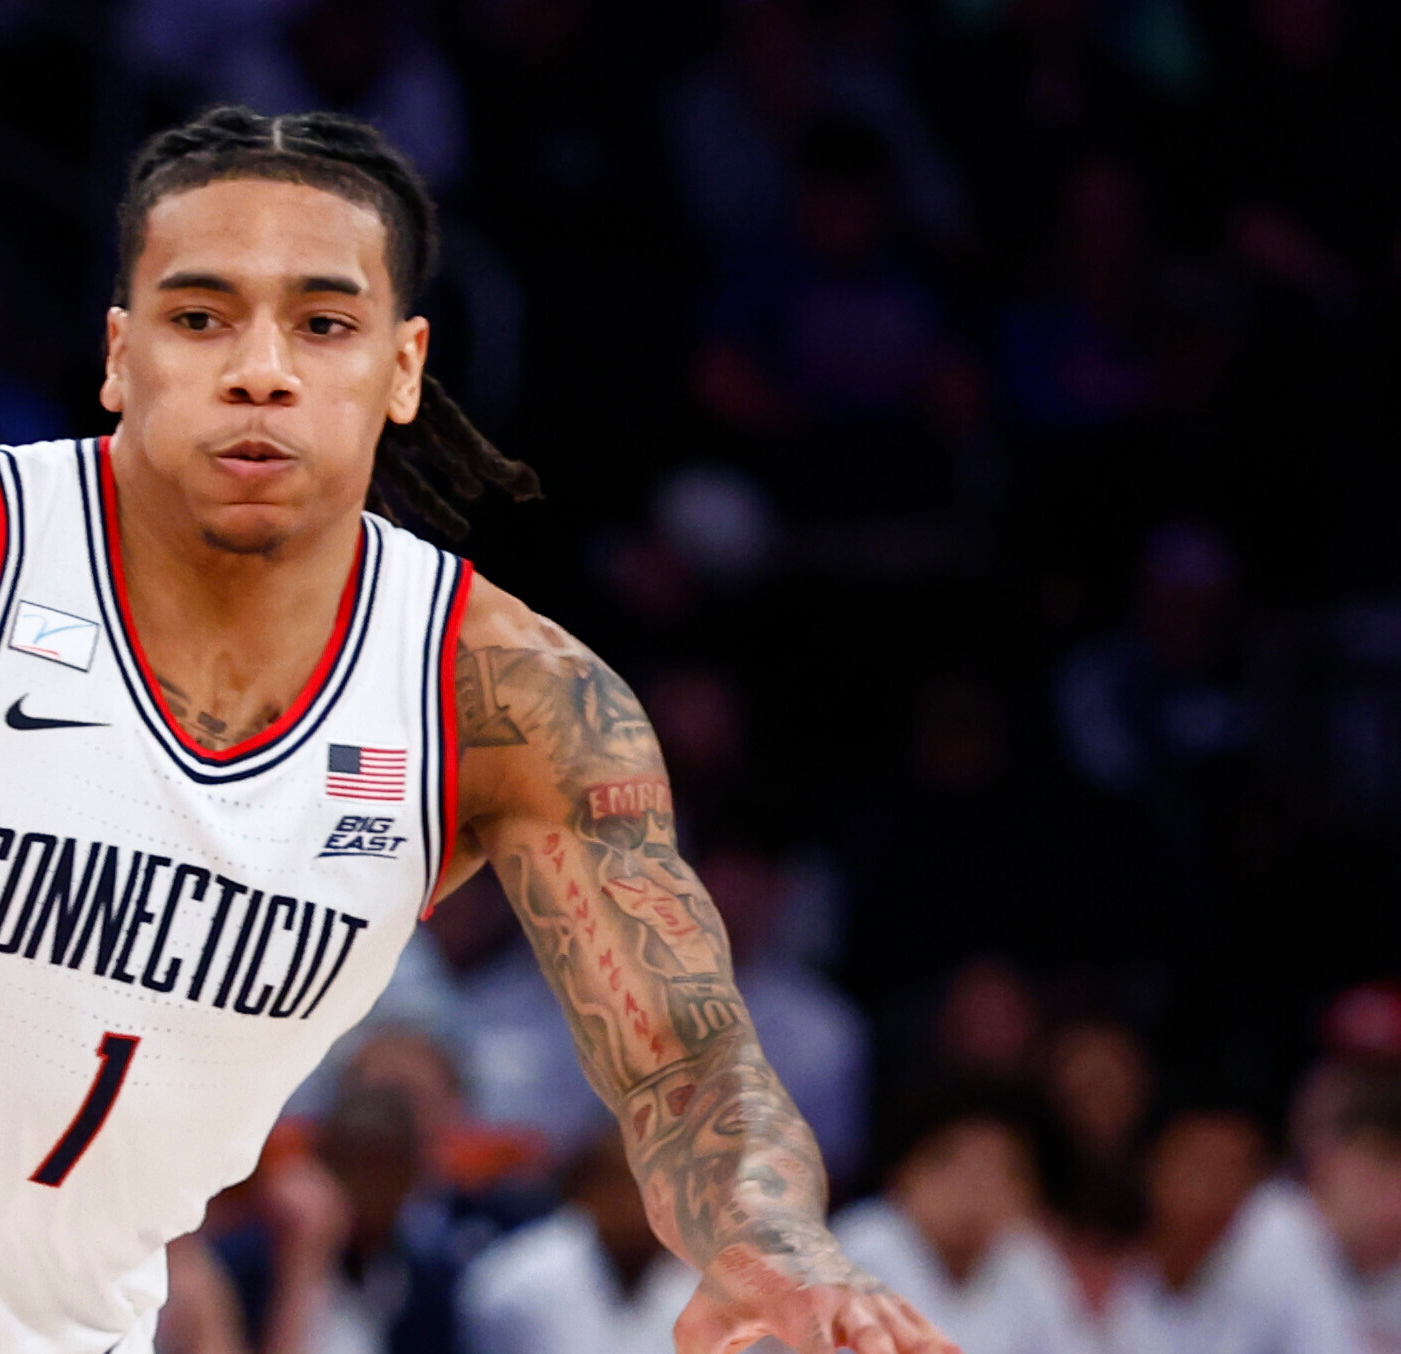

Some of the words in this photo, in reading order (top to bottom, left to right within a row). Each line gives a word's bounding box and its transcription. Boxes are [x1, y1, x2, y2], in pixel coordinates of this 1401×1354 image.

[334, 815, 395, 833] BIG
[324, 833, 408, 851] EAST
[28, 1031, 142, 1188] 1
